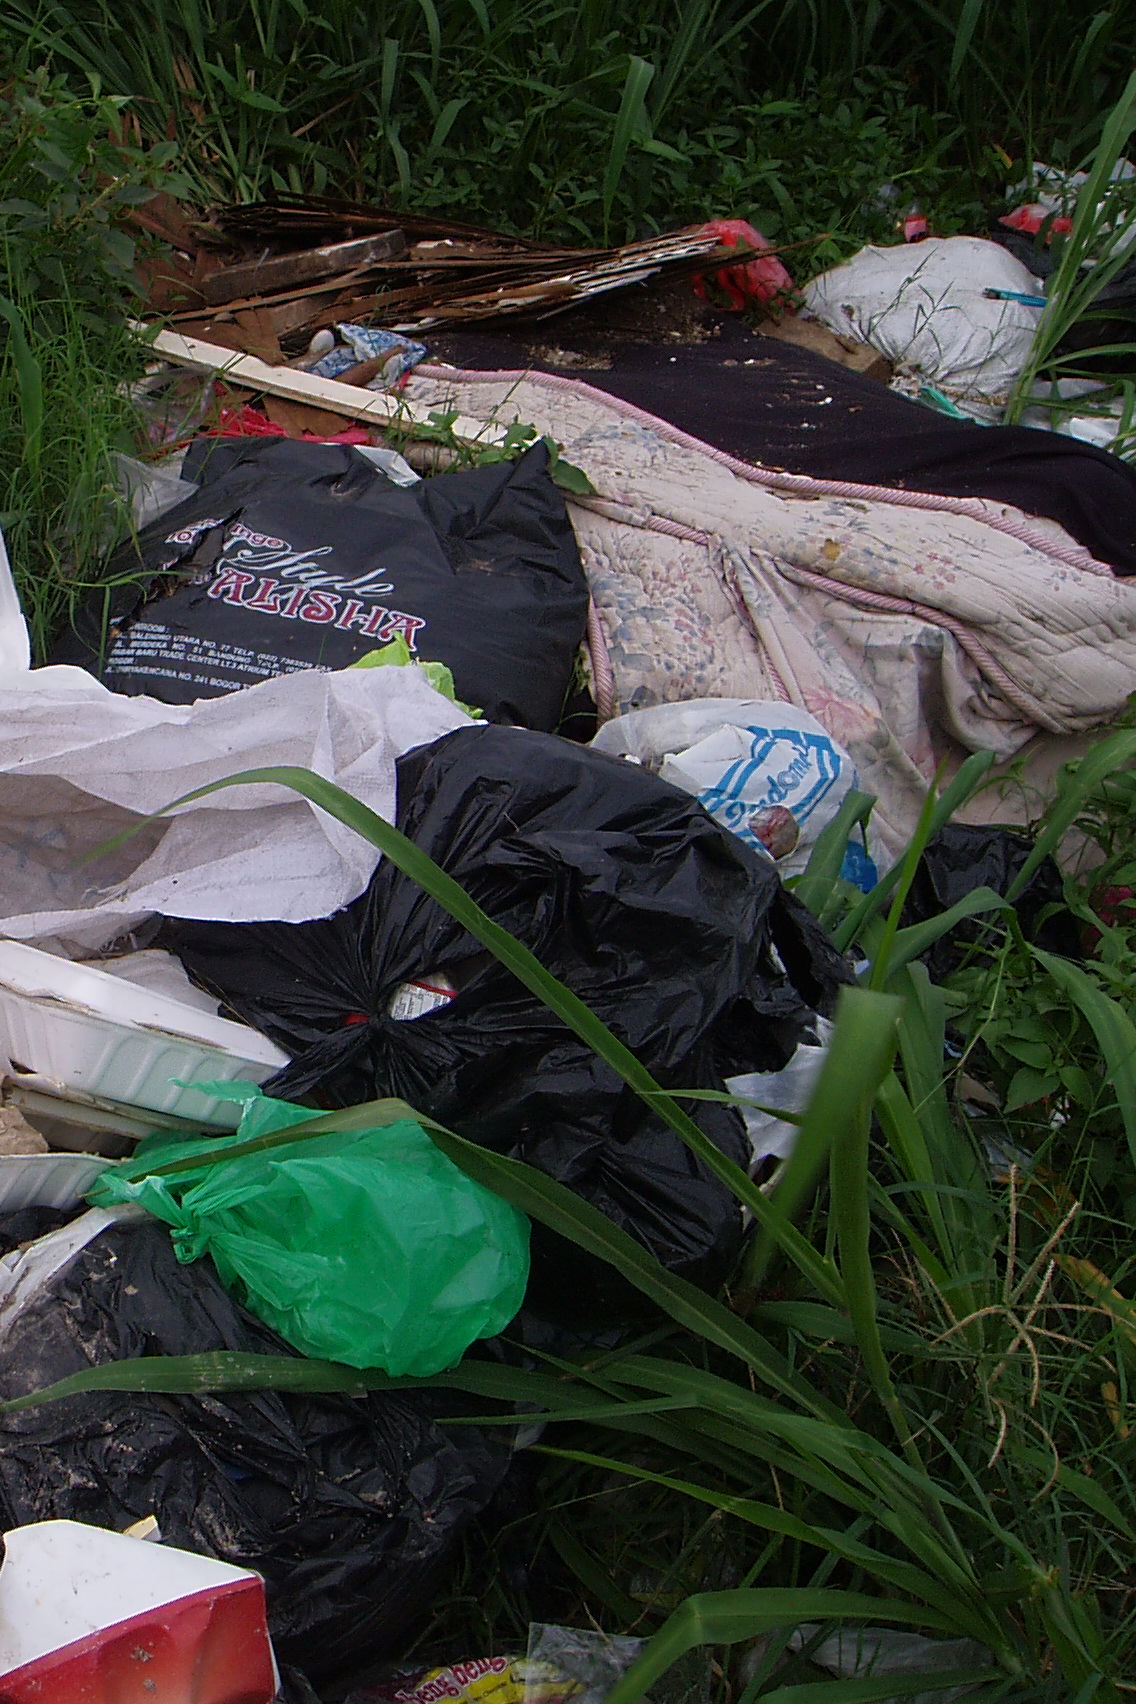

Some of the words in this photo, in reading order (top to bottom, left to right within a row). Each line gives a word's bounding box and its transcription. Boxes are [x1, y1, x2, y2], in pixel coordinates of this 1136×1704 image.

[216, 536, 395, 601] Style
[207, 566, 427, 652] ALISHA
[159, 650, 185, 660] TRADE
[187, 654, 220, 666] CENTER
